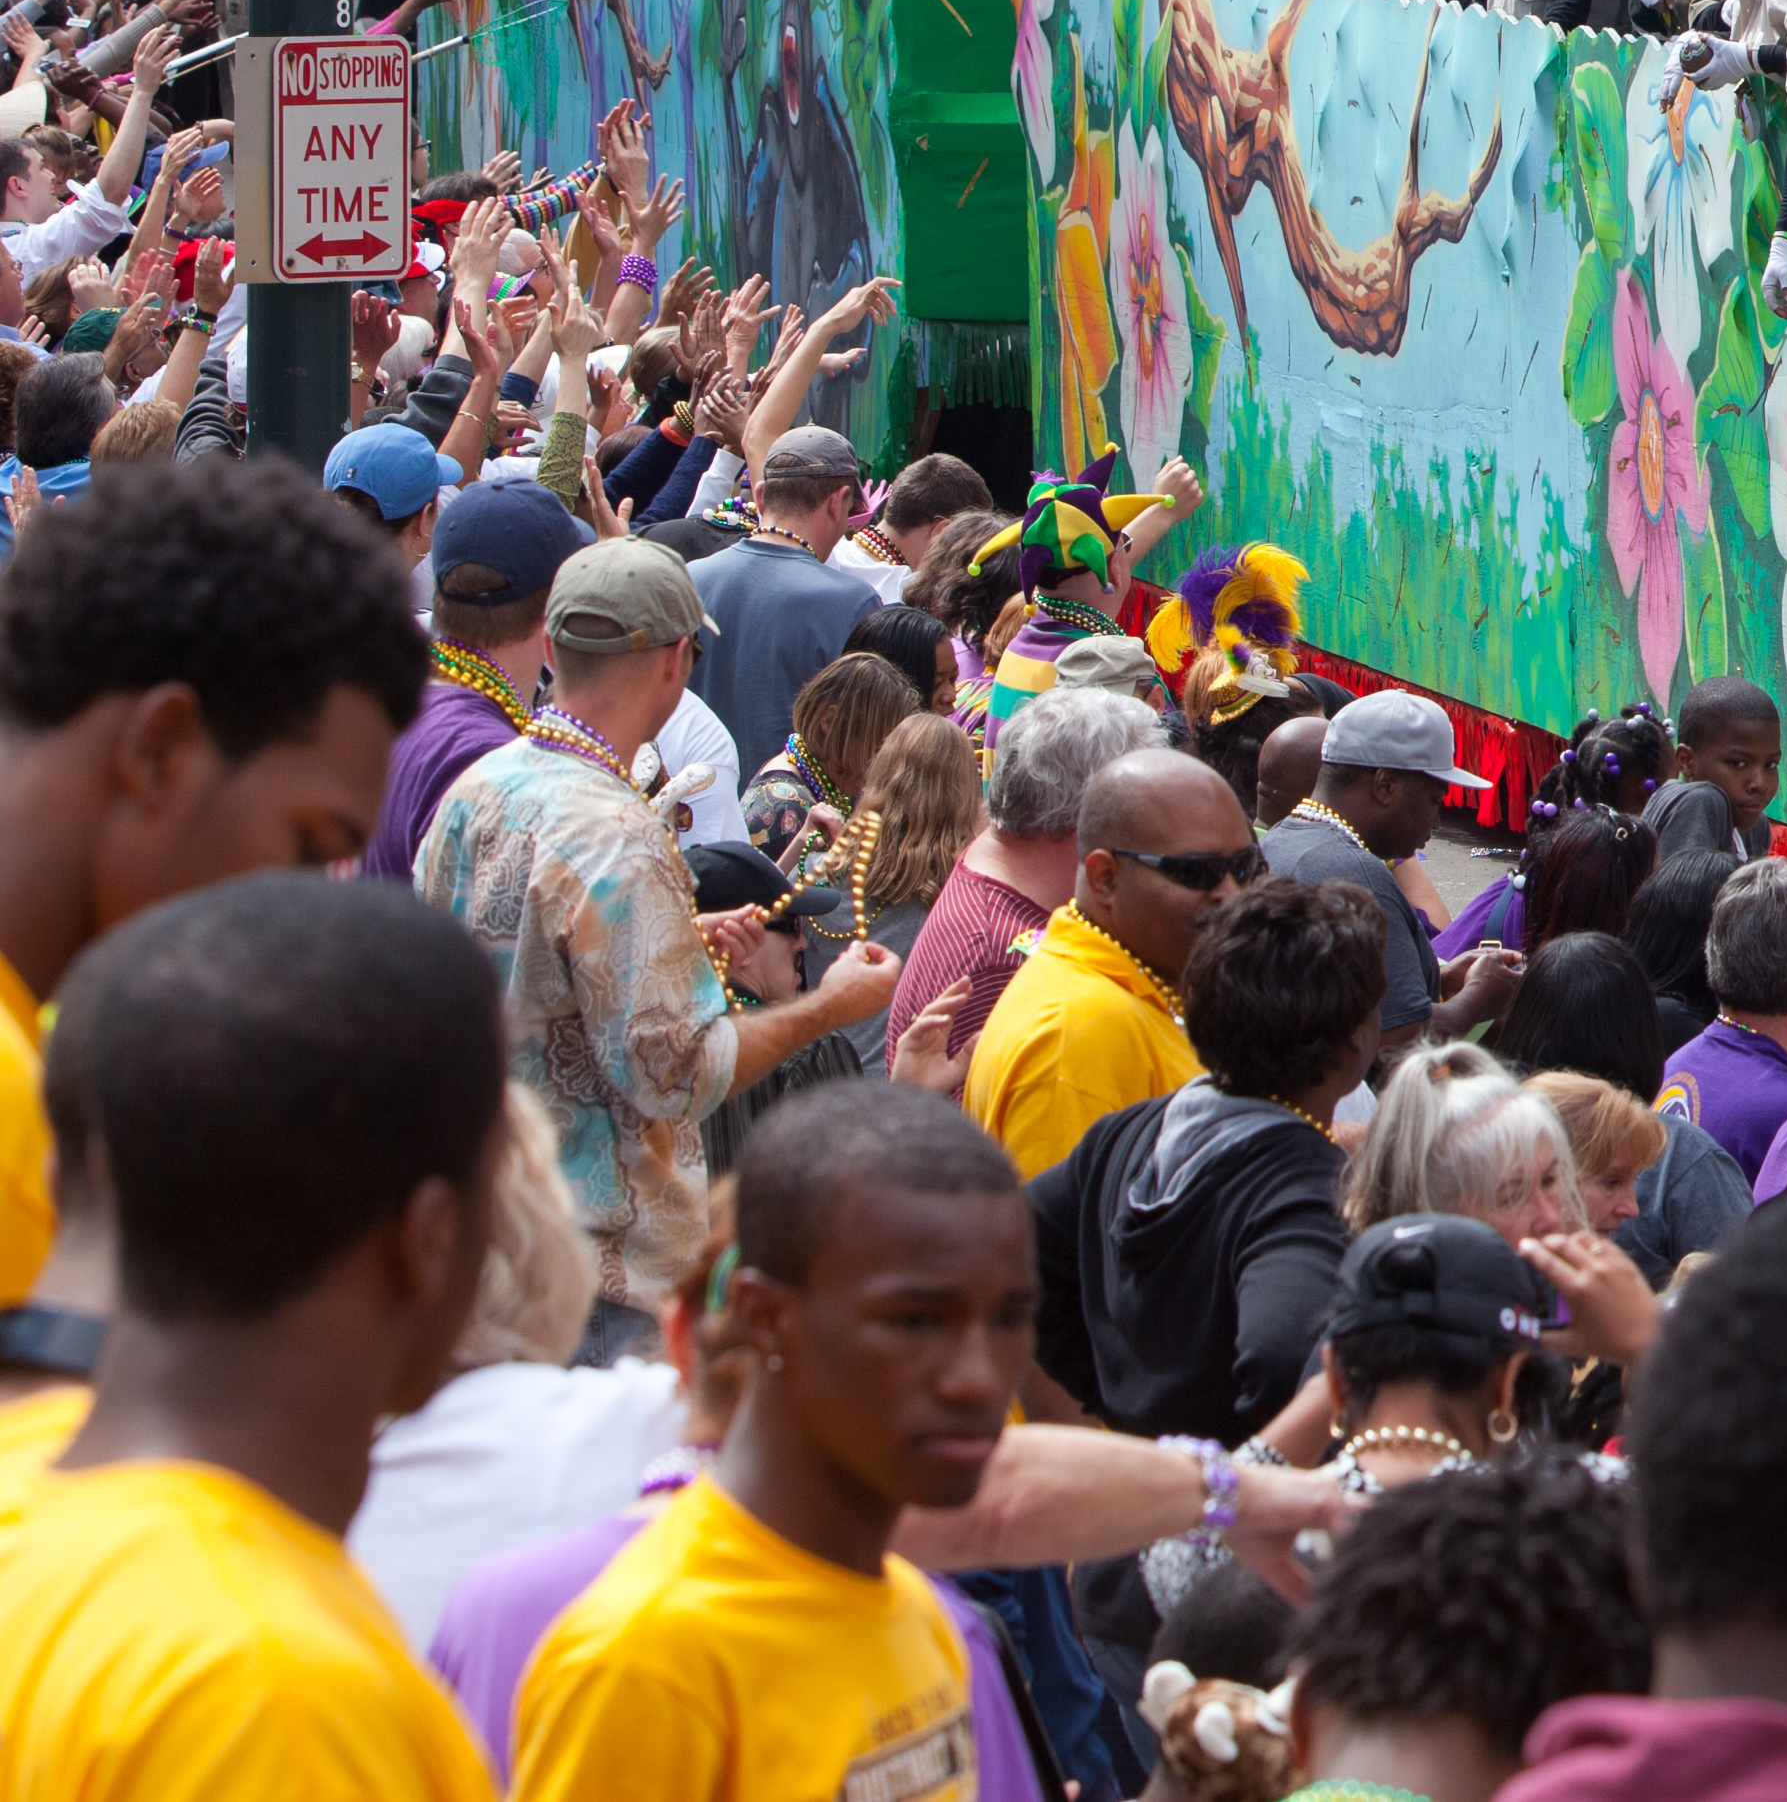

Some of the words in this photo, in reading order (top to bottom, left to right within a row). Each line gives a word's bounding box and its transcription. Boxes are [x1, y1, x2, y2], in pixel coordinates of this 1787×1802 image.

[282, 52, 317, 97] NO
[319, 54, 403, 90] STOPPING
[303, 124, 384, 163] ANY
[297, 185, 389, 224] TIME
